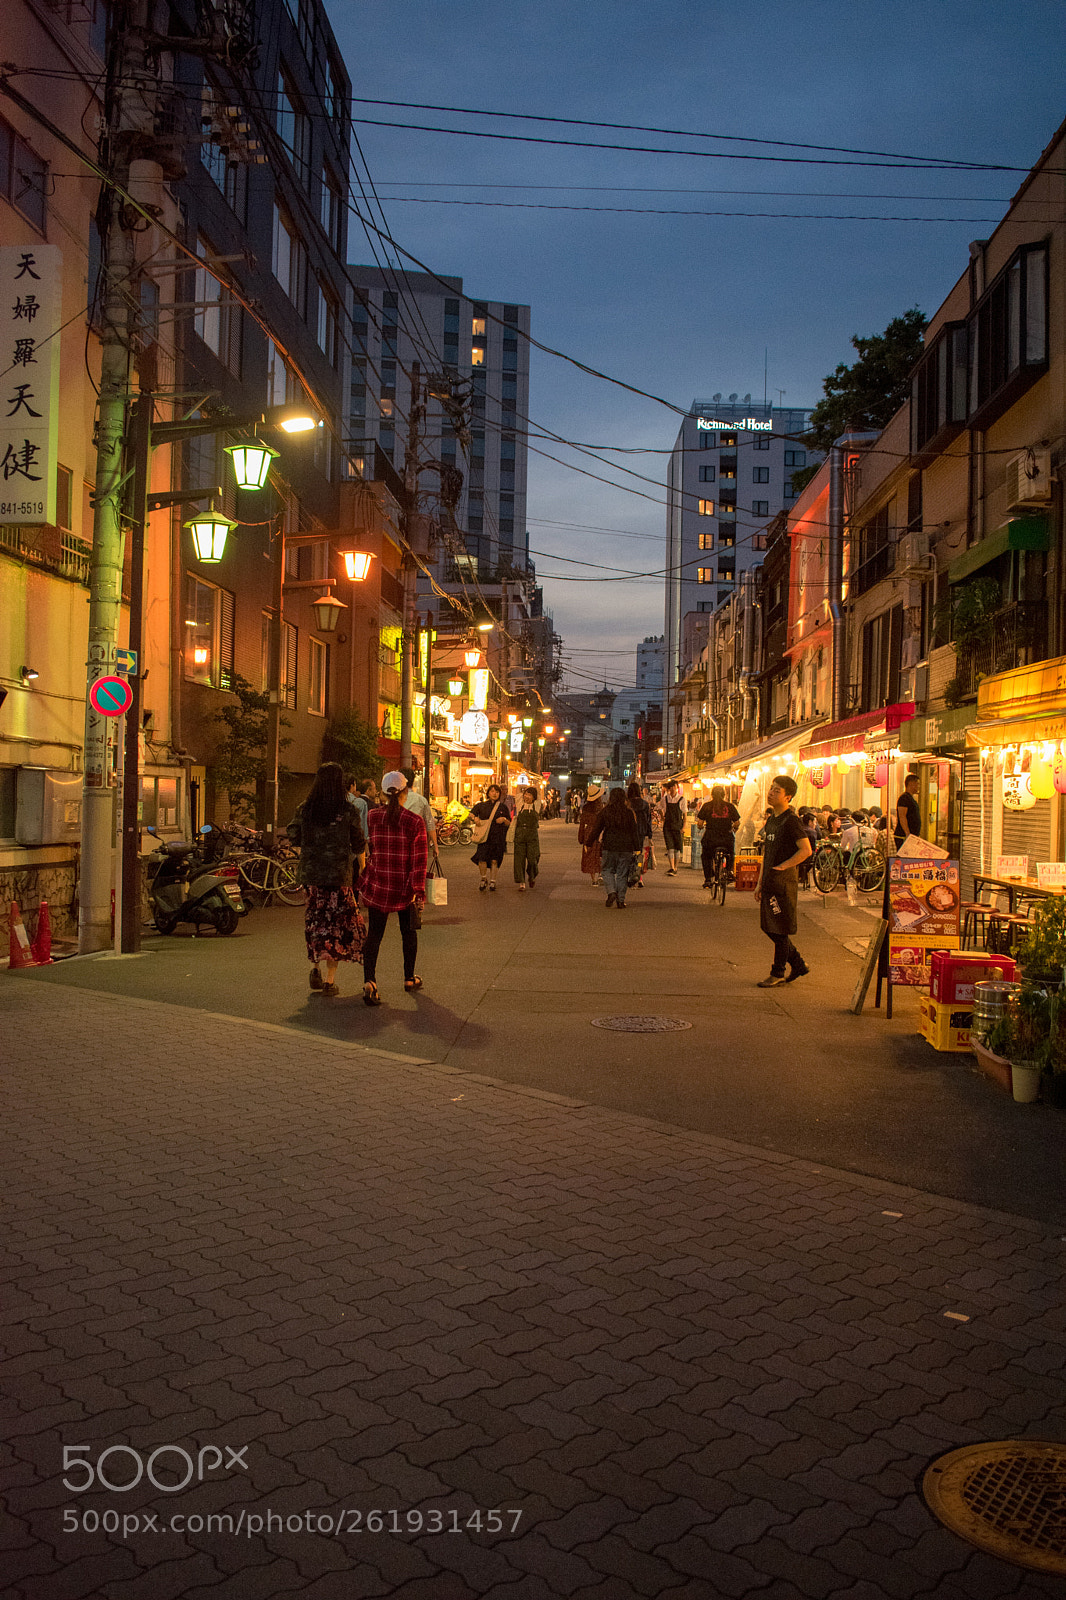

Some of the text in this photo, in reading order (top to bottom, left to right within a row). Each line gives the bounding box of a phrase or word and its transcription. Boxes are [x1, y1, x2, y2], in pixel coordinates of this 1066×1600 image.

[1, 253, 43, 482] 天婦羅天健
[747, 418, 772, 431] Hotel
[1, 502, 44, 515] 841-5519
[957, 1031, 973, 1042] KI
